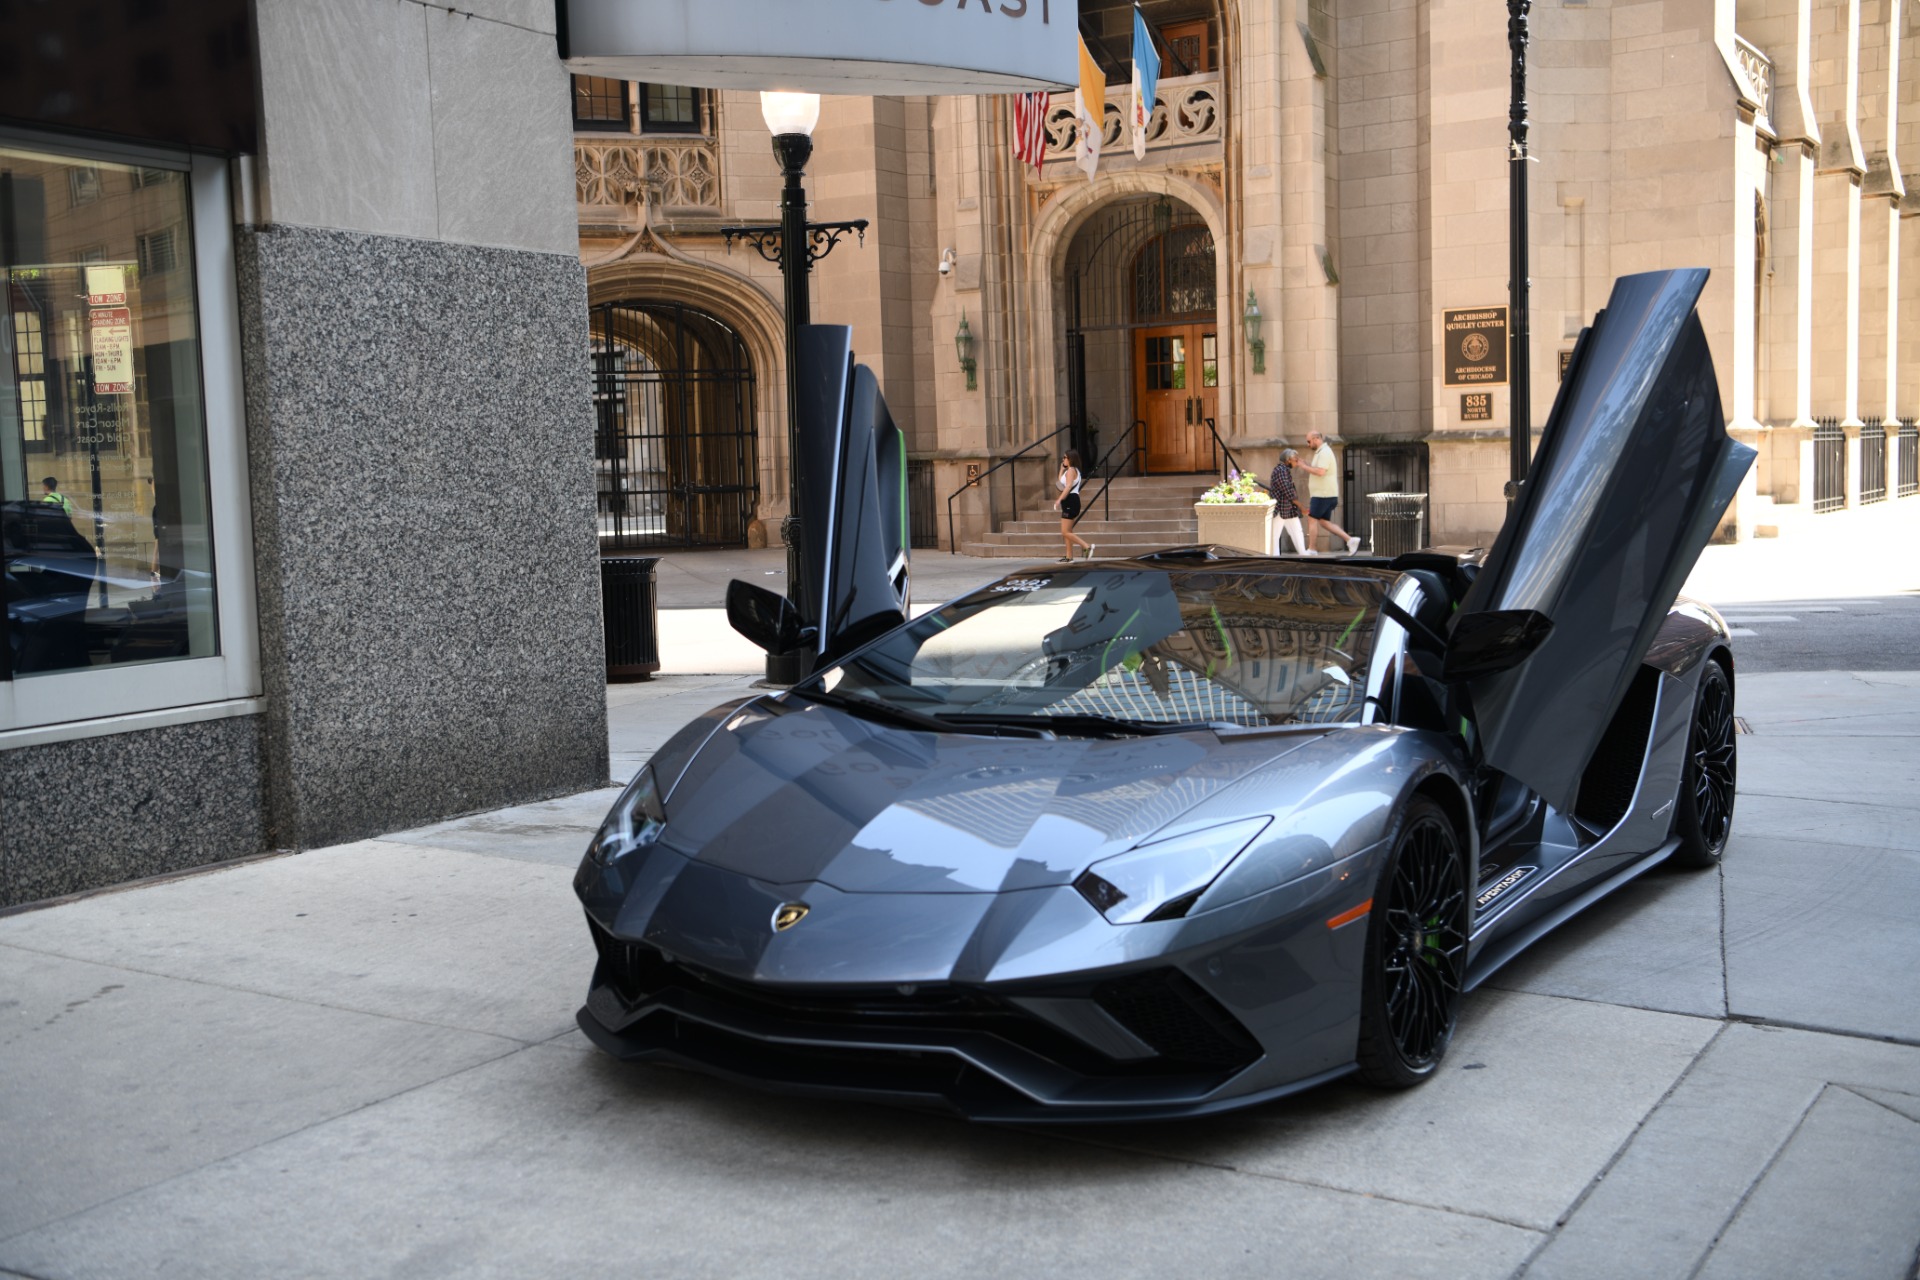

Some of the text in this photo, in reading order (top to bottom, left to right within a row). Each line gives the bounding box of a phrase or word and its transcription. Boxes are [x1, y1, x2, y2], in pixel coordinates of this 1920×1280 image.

[90, 294, 123, 304] TOW ZONE
[98, 311, 114, 319] MINUTE
[1453, 312, 1498, 322] ARCHBISHOP
[93, 317, 125, 326] STANDING ZONE
[1446, 320, 1505, 331] QUIGLEY CENTER
[1455, 365, 1497, 373] ARCHDIOCESE
[96, 383, 110, 393] TOW
[1466, 395, 1487, 407] 835
